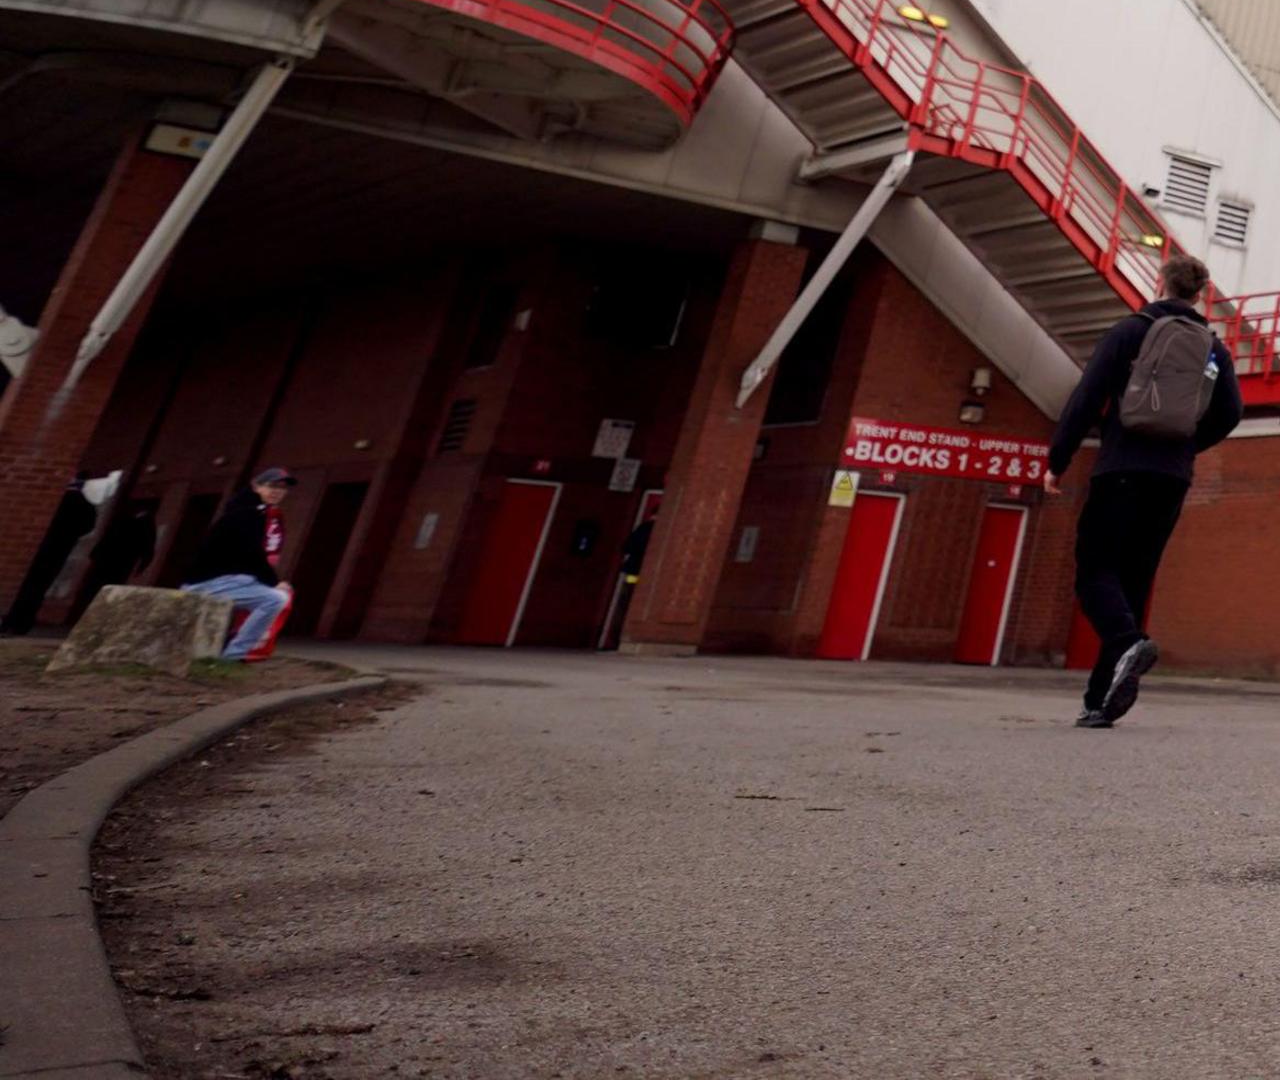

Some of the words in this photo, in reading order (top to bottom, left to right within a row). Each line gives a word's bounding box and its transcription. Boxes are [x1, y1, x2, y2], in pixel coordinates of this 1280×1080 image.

[856, 423, 898, 439] TRENT
[899, 428, 926, 443] END
[928, 432, 970, 448] STAND
[980, 439, 1020, 454] UPPER
[854, 440, 951, 470] BLOCKS
[958, 454, 969, 472] 1
[987, 456, 1003, 475] 2
[1006, 458, 1022, 477] &
[1027, 460, 1042, 479] 3
